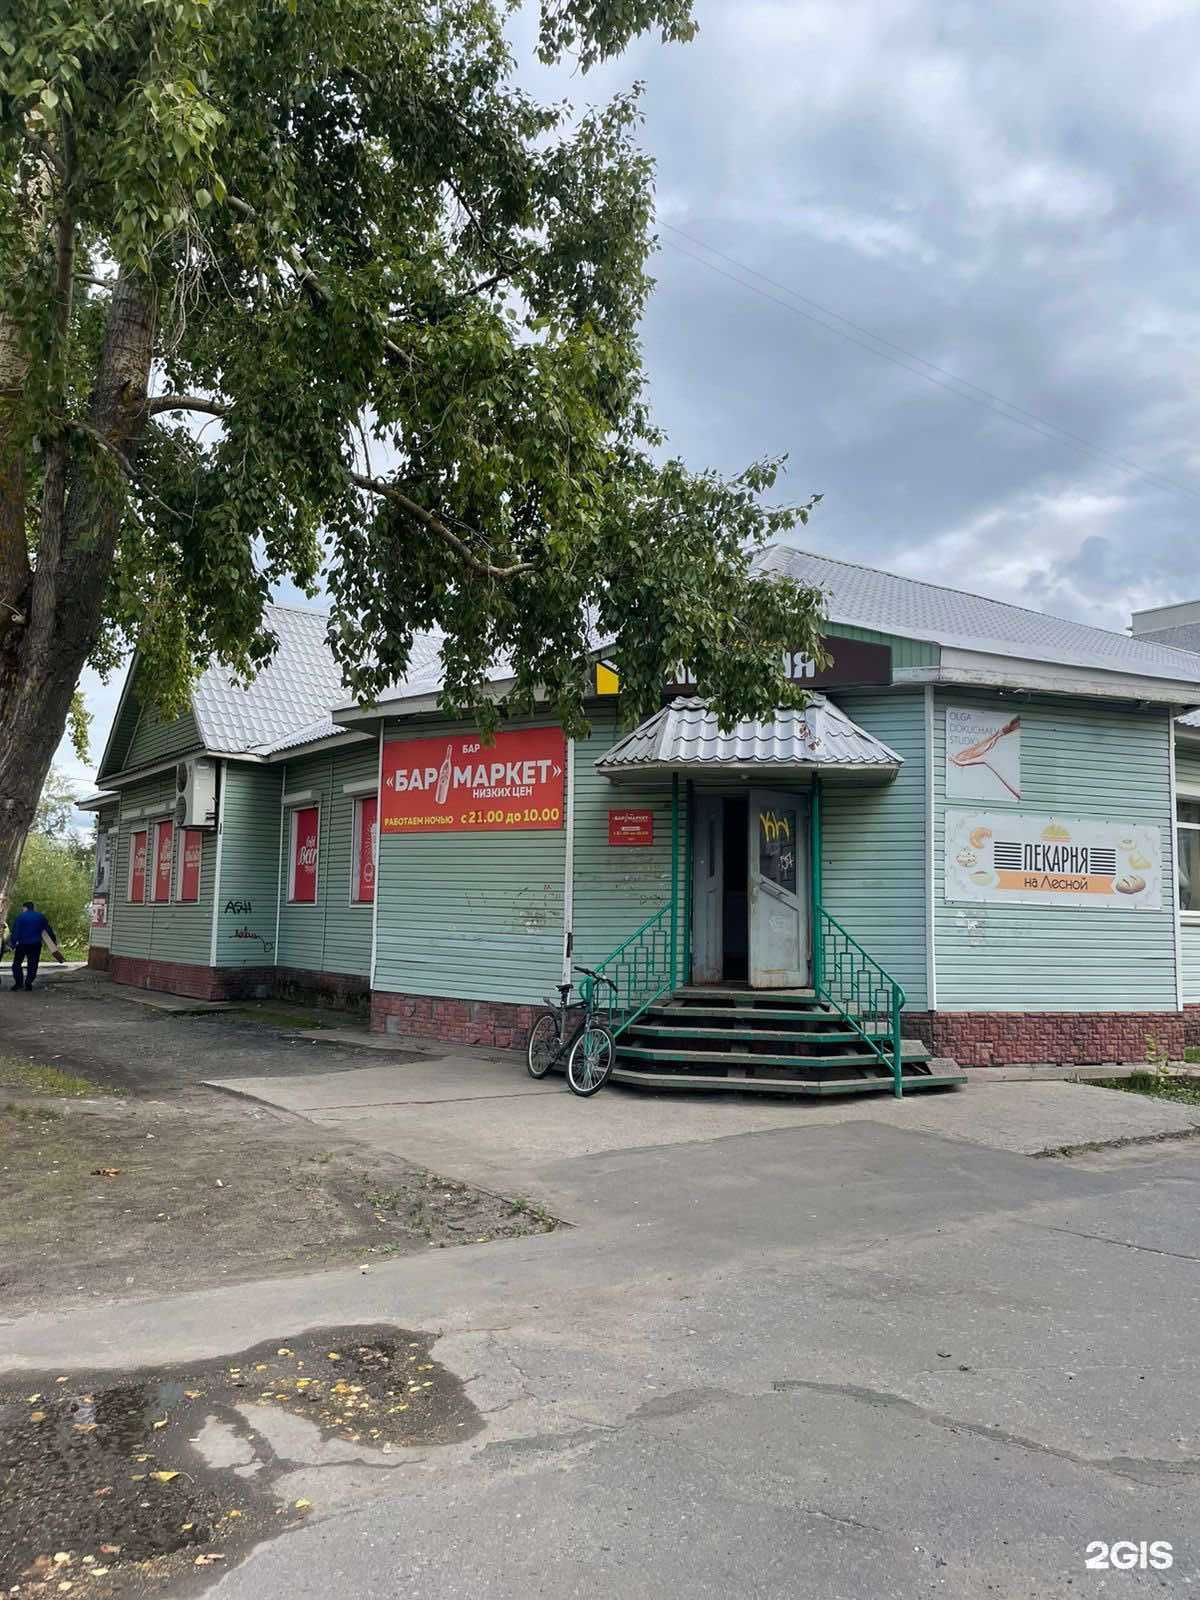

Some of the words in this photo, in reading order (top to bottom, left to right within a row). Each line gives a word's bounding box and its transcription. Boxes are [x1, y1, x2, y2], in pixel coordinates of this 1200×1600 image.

[462, 744, 480, 754] БАР
[472, 787, 510, 799] НИЗКИХ
[512, 786, 533, 797] ЦЕН
[384, 816, 424, 826] РАБОТАЕМ
[424, 815, 454, 825] НОЧЬЮ
[468, 810, 503, 823] 21.00
[505, 811, 522, 824] до
[524, 808, 559, 821] 10.00
[1023, 844, 1089, 874] ПЕКАРНЯ
[1024, 877, 1038, 888] на
[1041, 877, 1088, 890] Лесной
